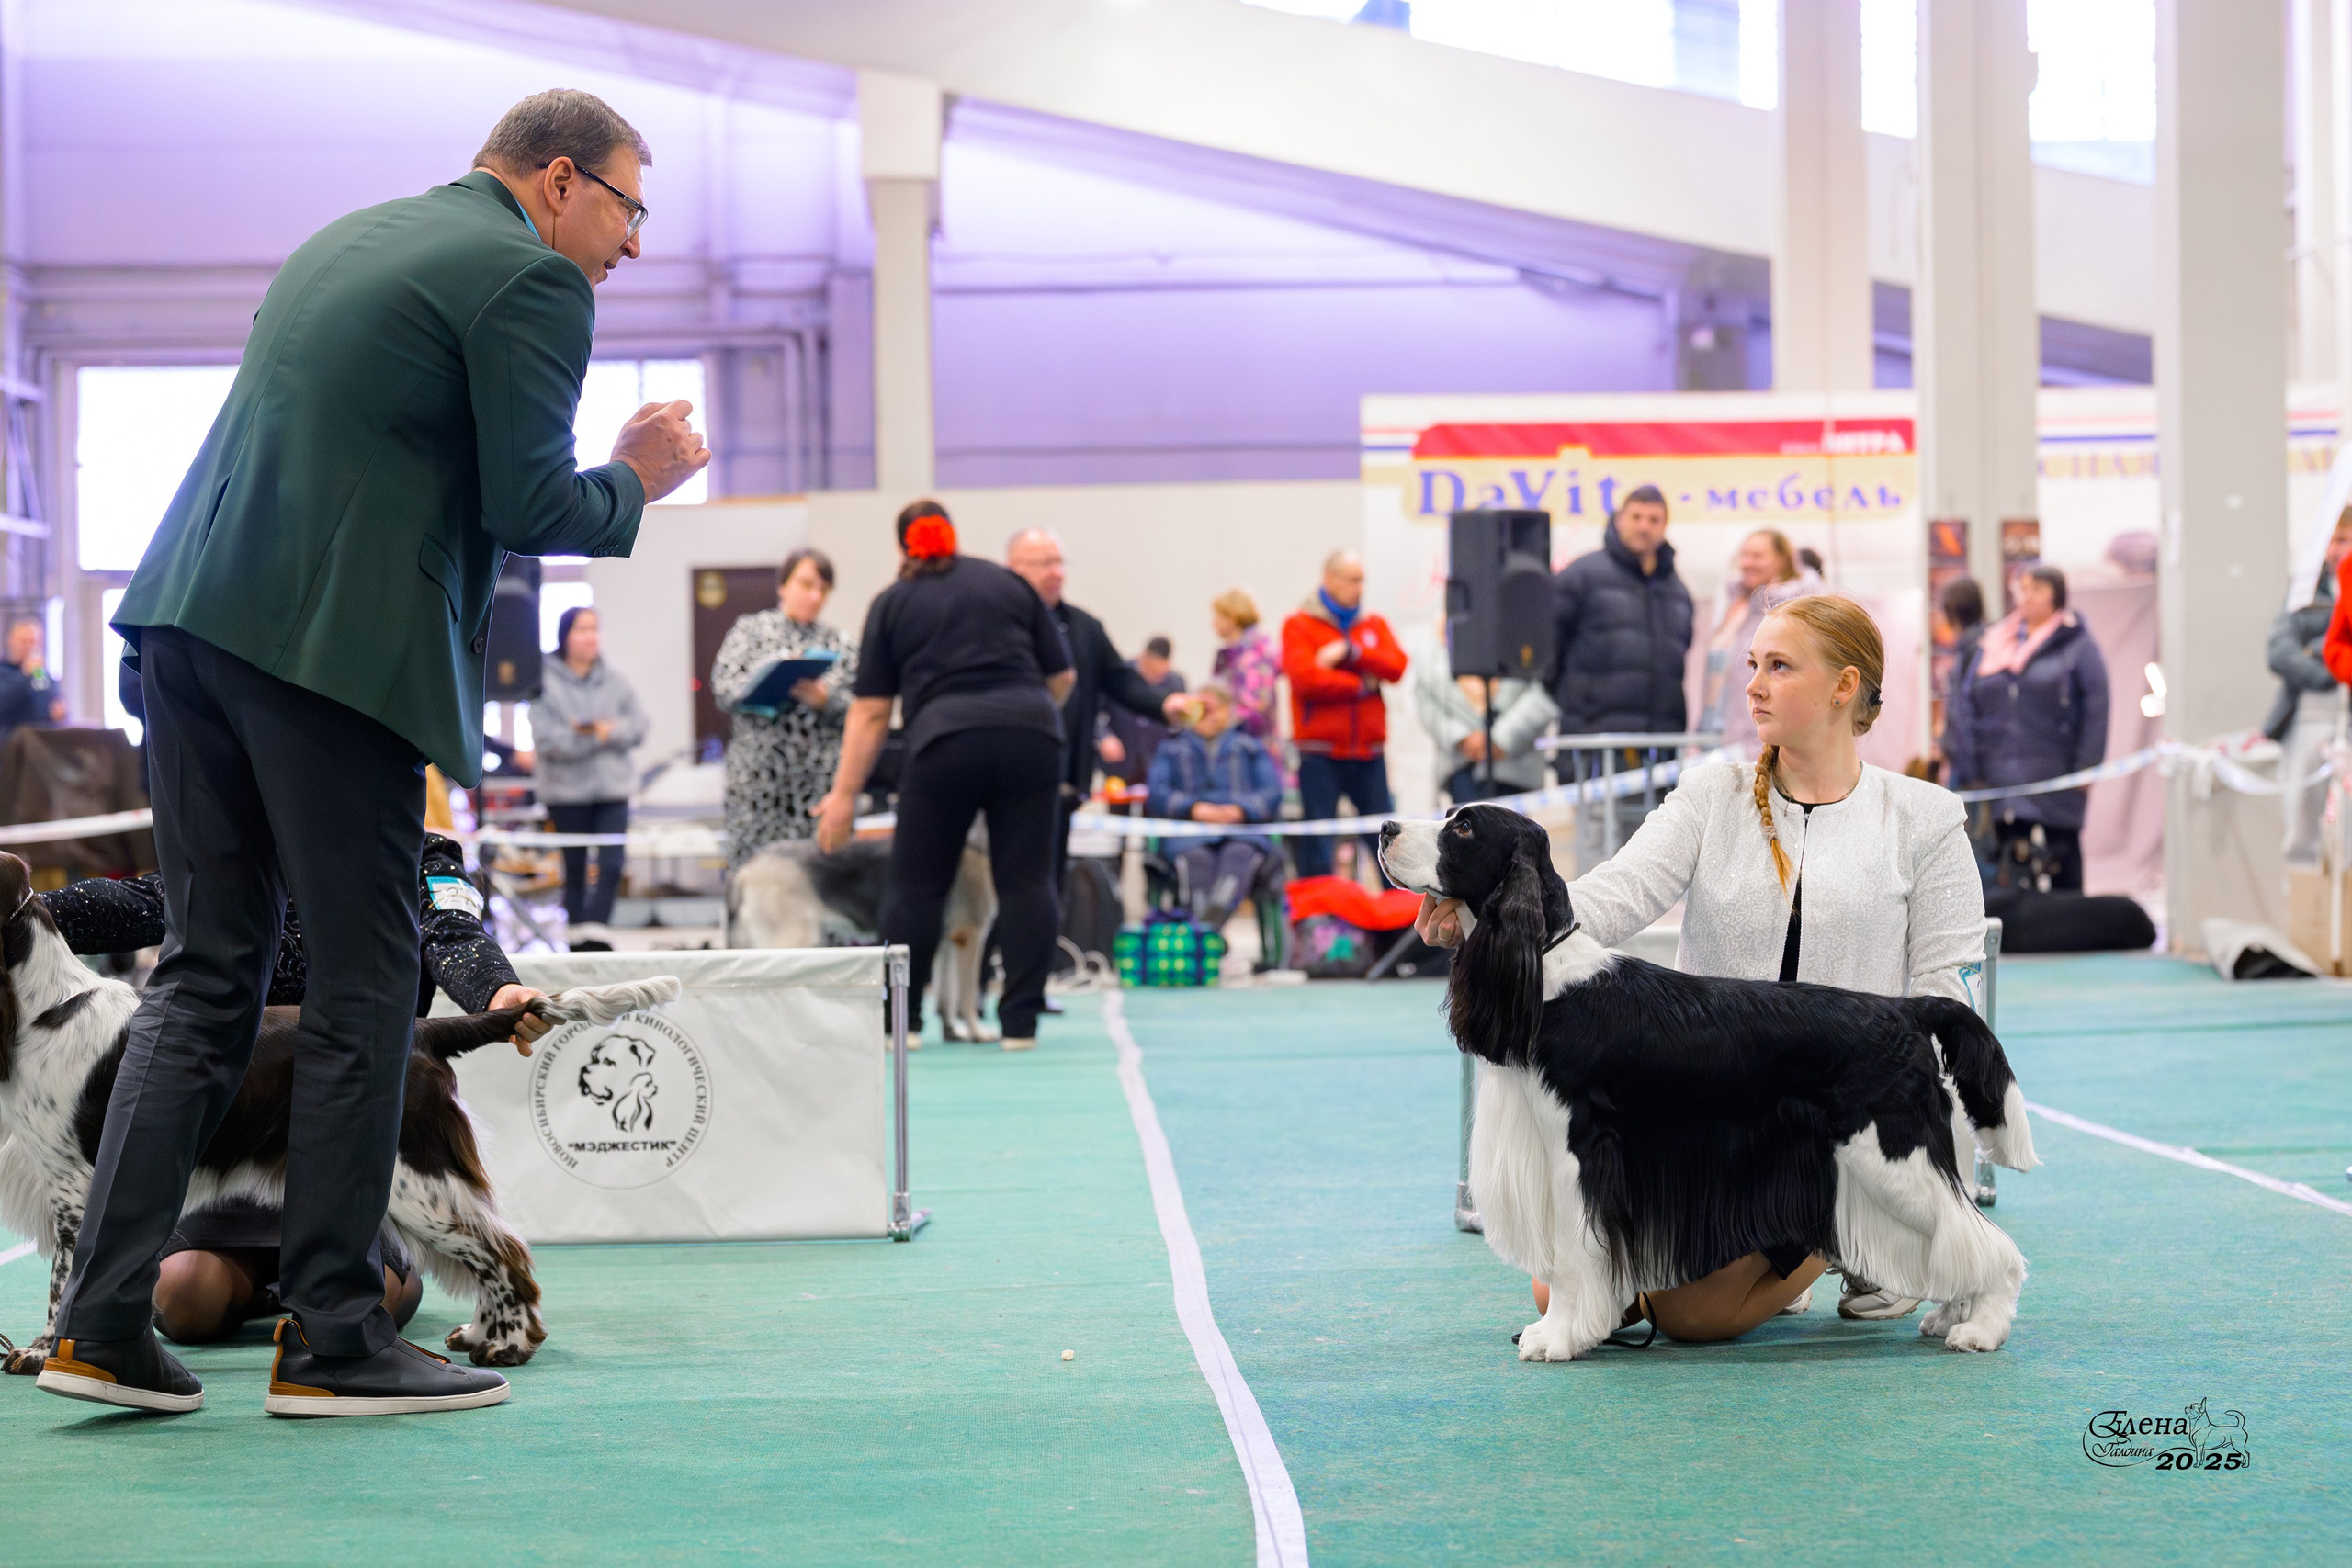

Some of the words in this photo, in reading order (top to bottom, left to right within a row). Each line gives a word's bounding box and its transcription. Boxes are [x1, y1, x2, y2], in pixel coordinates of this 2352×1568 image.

[534, 1052, 579, 1170] НОВОСИБИРСКИЙ
[634, 1013, 708, 1125] КИНОЛОГИЧЕСКИЙ
[665, 1127, 700, 1168] ЦЕНТР
